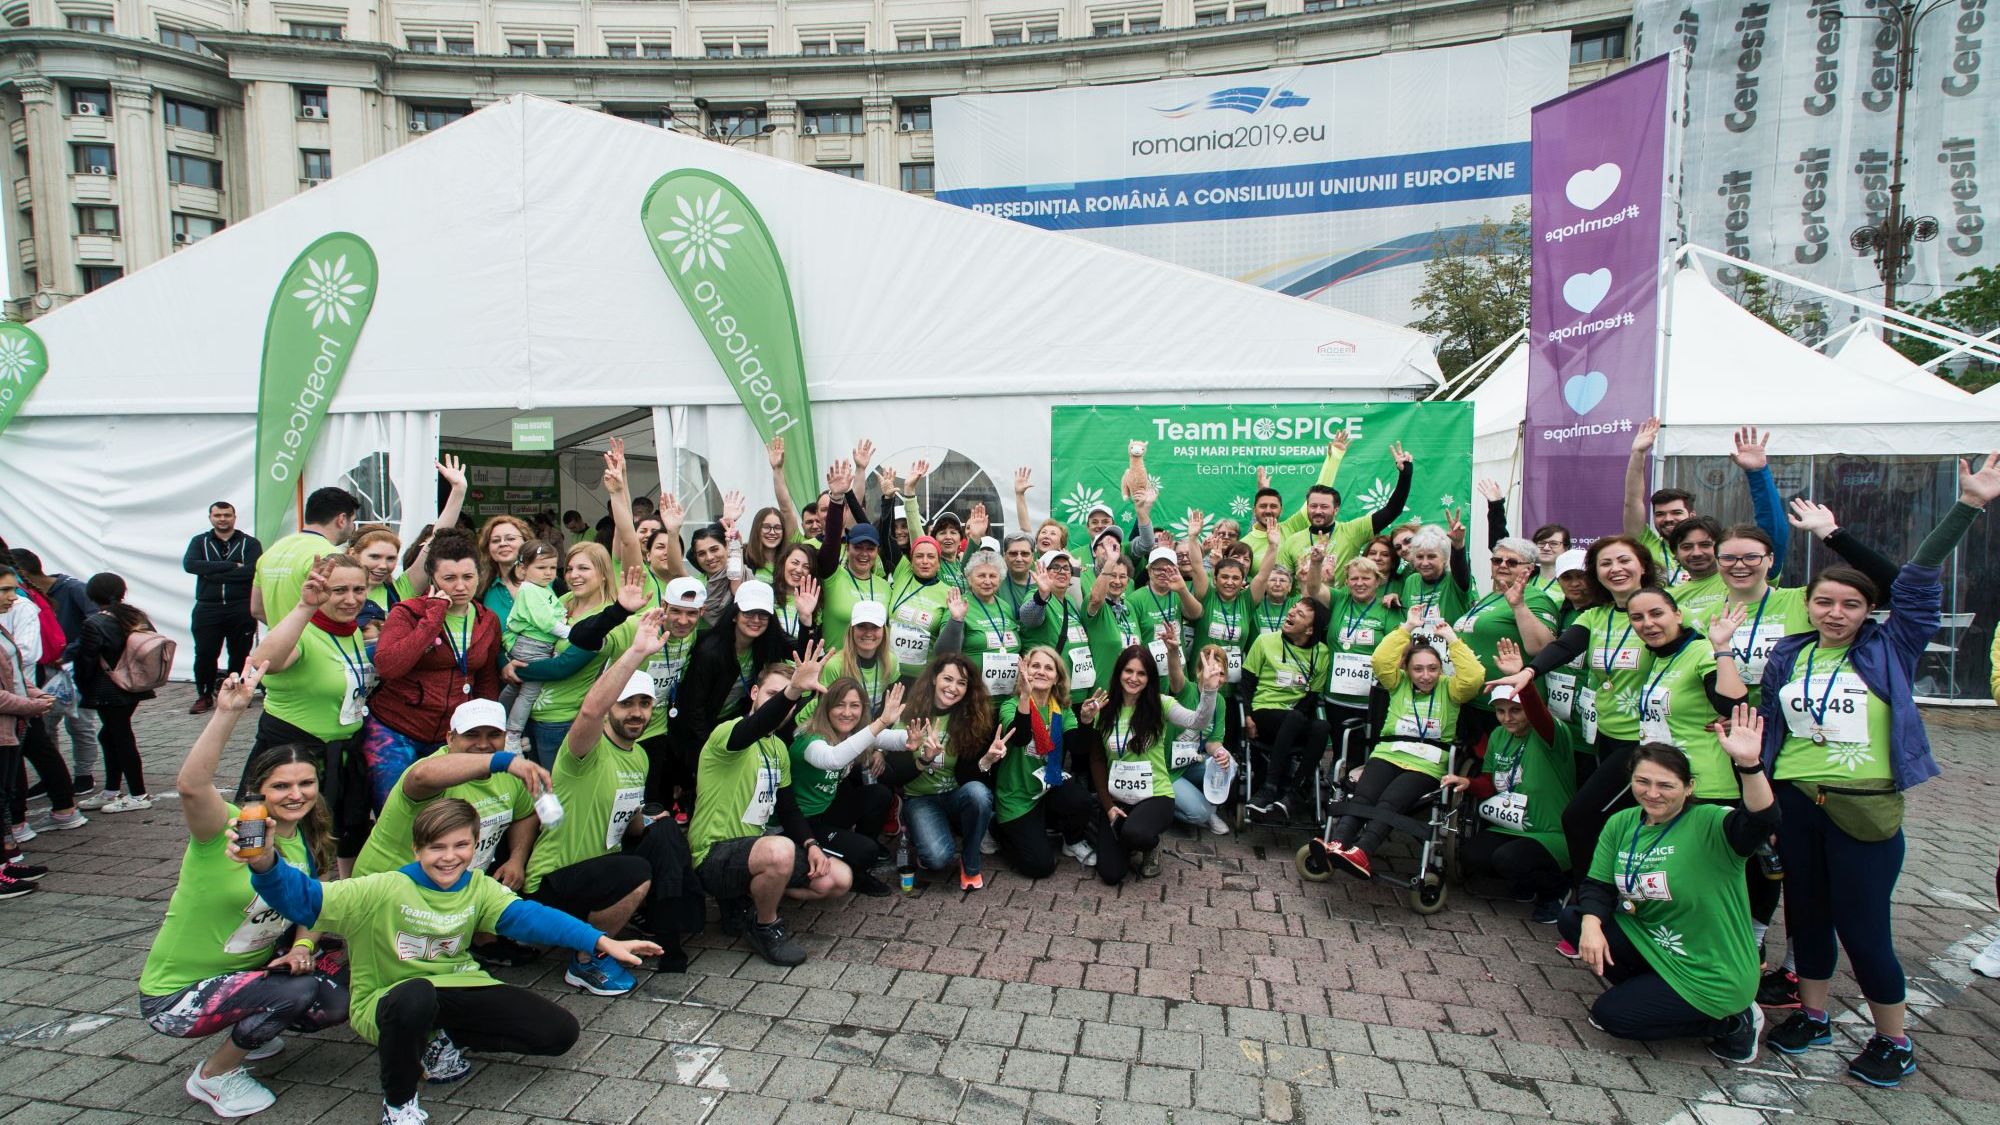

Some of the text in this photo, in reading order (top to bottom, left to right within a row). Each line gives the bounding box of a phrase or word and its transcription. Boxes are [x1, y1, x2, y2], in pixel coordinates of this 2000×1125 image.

[1724, 2, 1770, 133] Ceresit
[1132, 122, 1326, 157] romania2019.eu
[1085, 188, 1169, 213] ROMÂNĂ
[1174, 190, 1189, 207] A
[1194, 181, 1314, 206] CONSILIULUI
[1320, 173, 1397, 196] UNIUNII
[1403, 161, 1516, 189] EUROPENE
[1938, 137, 1984, 257] Ceresit
[1794, 148, 1831, 264] Ceresit
[1152, 417, 1363, 441] Team HOSPICE
[1201, 446, 1228, 456] MARI
[1232, 446, 1277, 456] PENTRU
[1279, 445, 1330, 456] SPERAN
[895, 638, 923, 650] CP122
[985, 669, 1017, 679] CP1673
[1334, 667, 1370, 679] CP1648
[825, 769, 839, 780] Tea
[1114, 779, 1147, 790] CP345
[1482, 805, 1519, 823] CP1663
[1634, 845, 1675, 861] HPICE
[400, 904, 432, 919] Team
